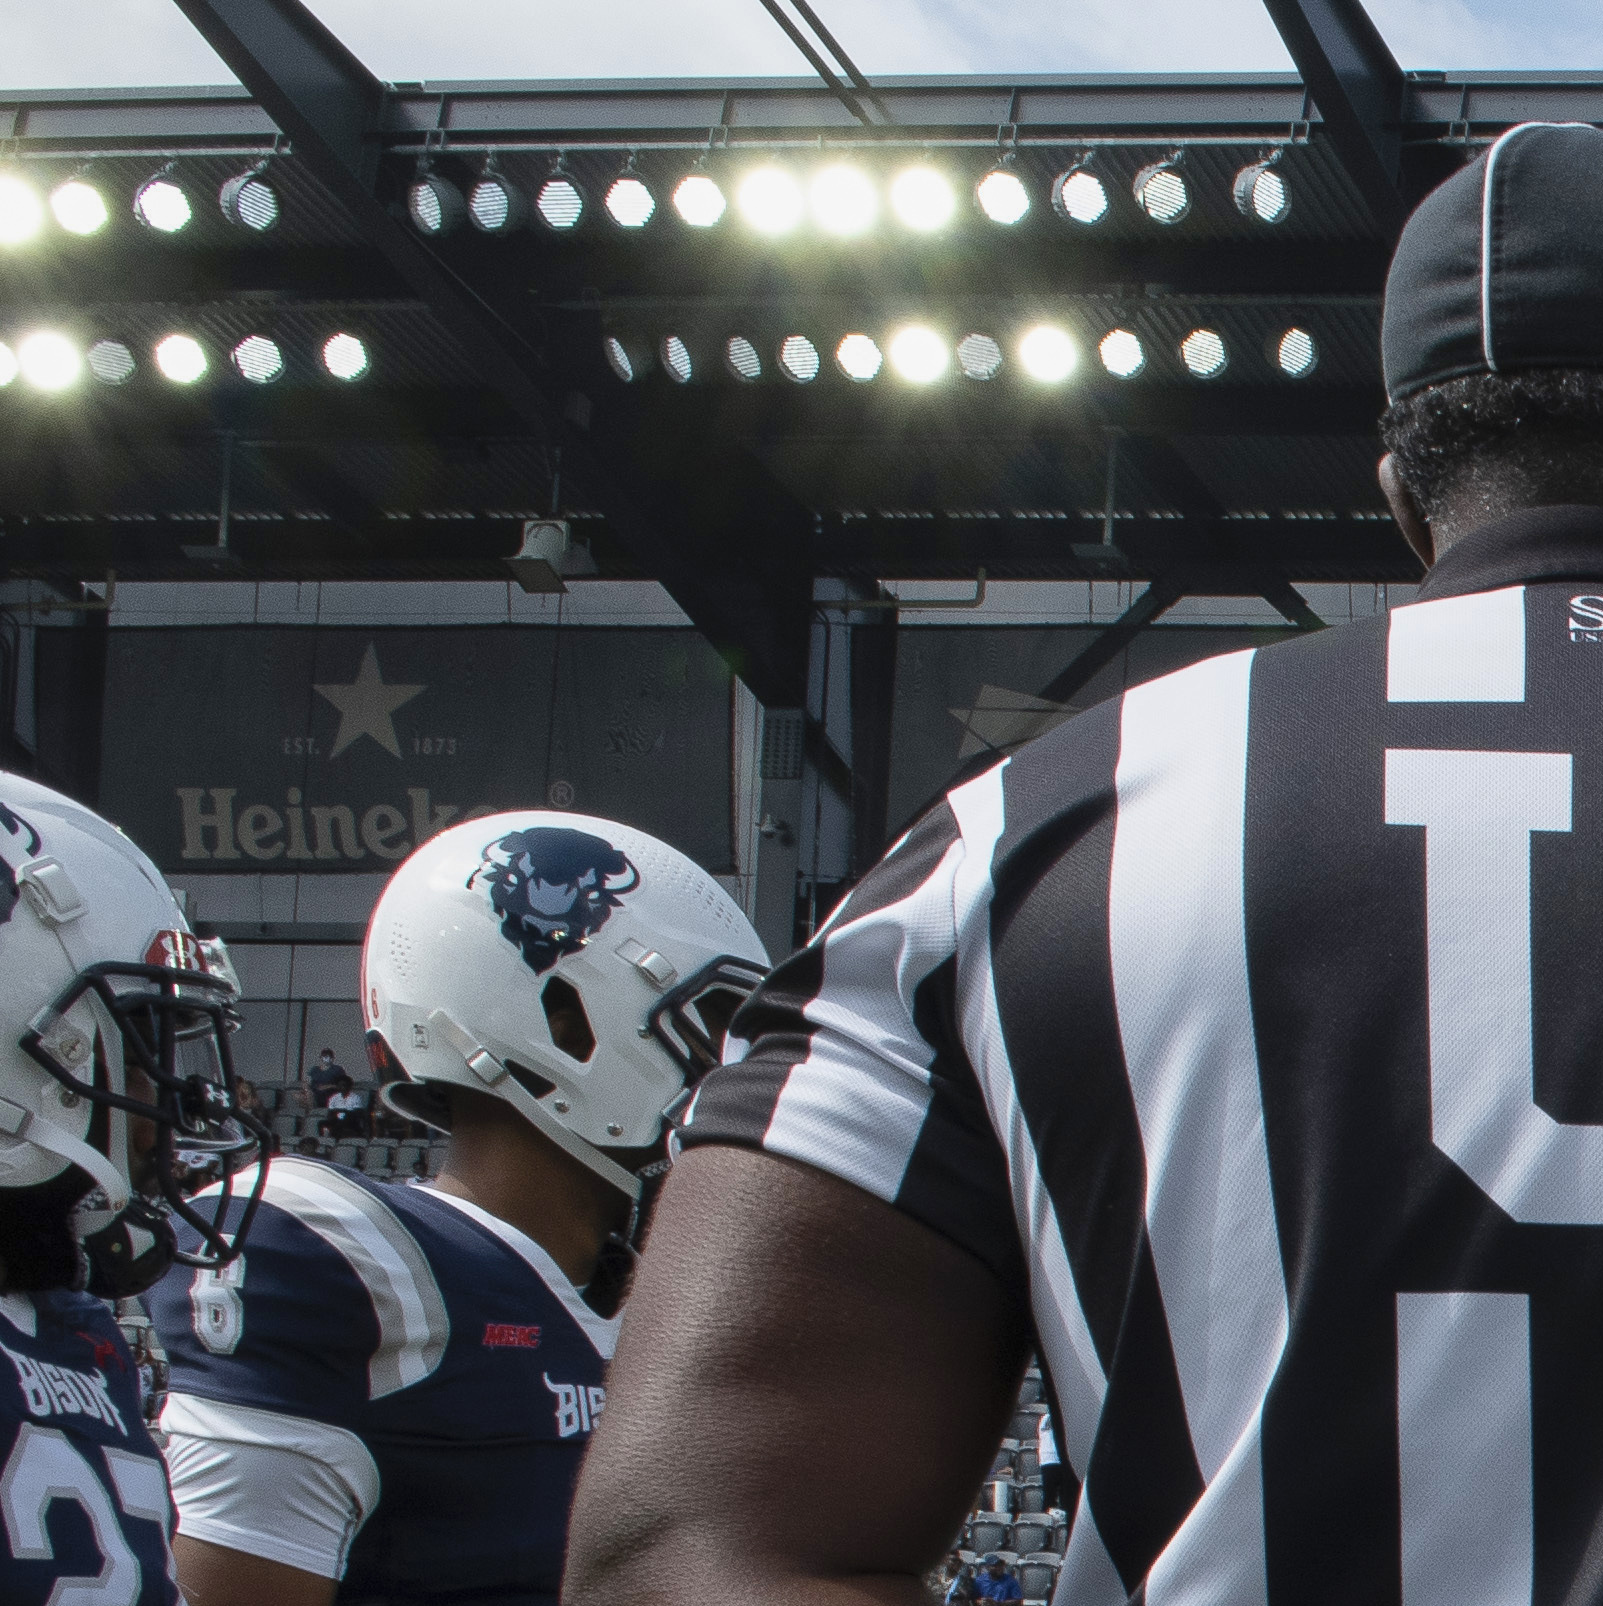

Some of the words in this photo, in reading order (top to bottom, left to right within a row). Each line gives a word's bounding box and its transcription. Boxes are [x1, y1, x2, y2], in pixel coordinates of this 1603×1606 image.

[283, 737, 321, 756] EST.
[176, 783, 499, 860] Heinek
[541, 1370, 608, 1438] BIS
